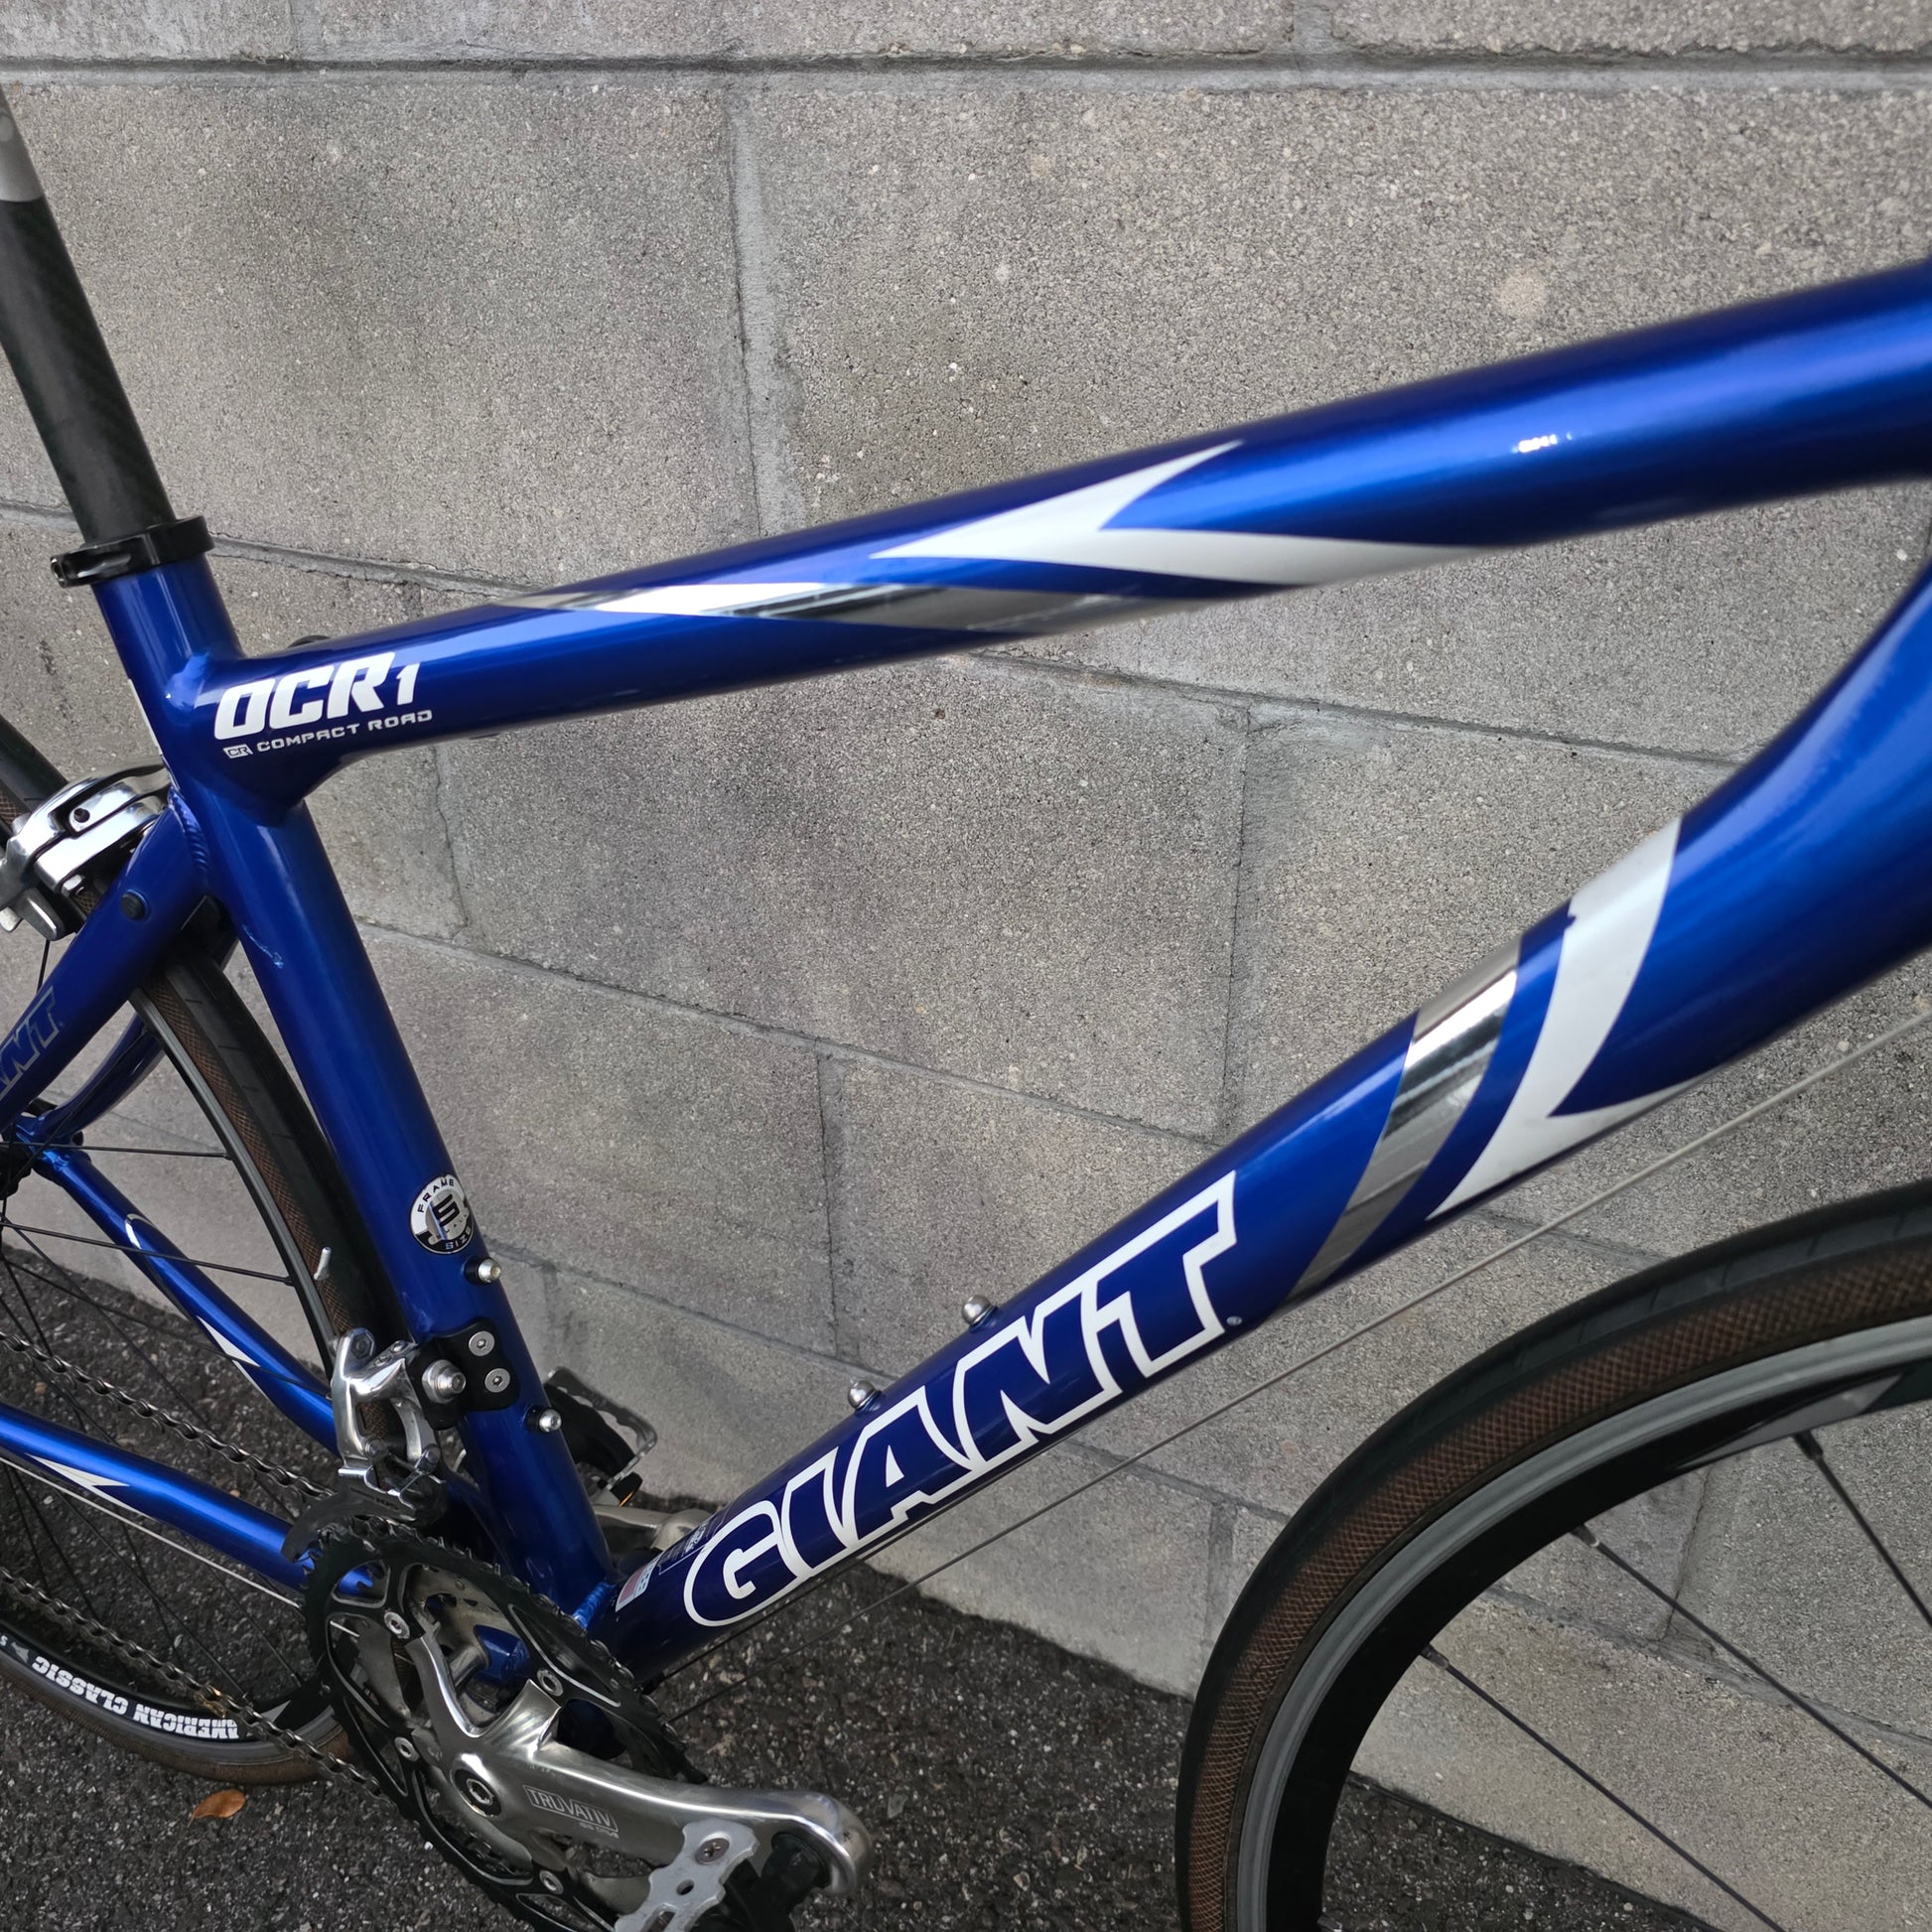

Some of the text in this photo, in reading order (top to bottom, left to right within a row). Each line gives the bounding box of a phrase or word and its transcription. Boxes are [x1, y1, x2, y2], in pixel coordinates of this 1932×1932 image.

[256, 723, 360, 753] COMPACT
[368, 709, 433, 732] ROAD
[0, 985, 60, 1099] NT
[418, 1178, 455, 1213] FRAME
[432, 1193, 460, 1227] S
[446, 1226, 472, 1250] SIZE
[684, 1171, 1237, 1627] GIANT
[32, 1656, 239, 1739] AMERICAN CLASSIC
[526, 1788, 611, 1827] TRUVATIV
